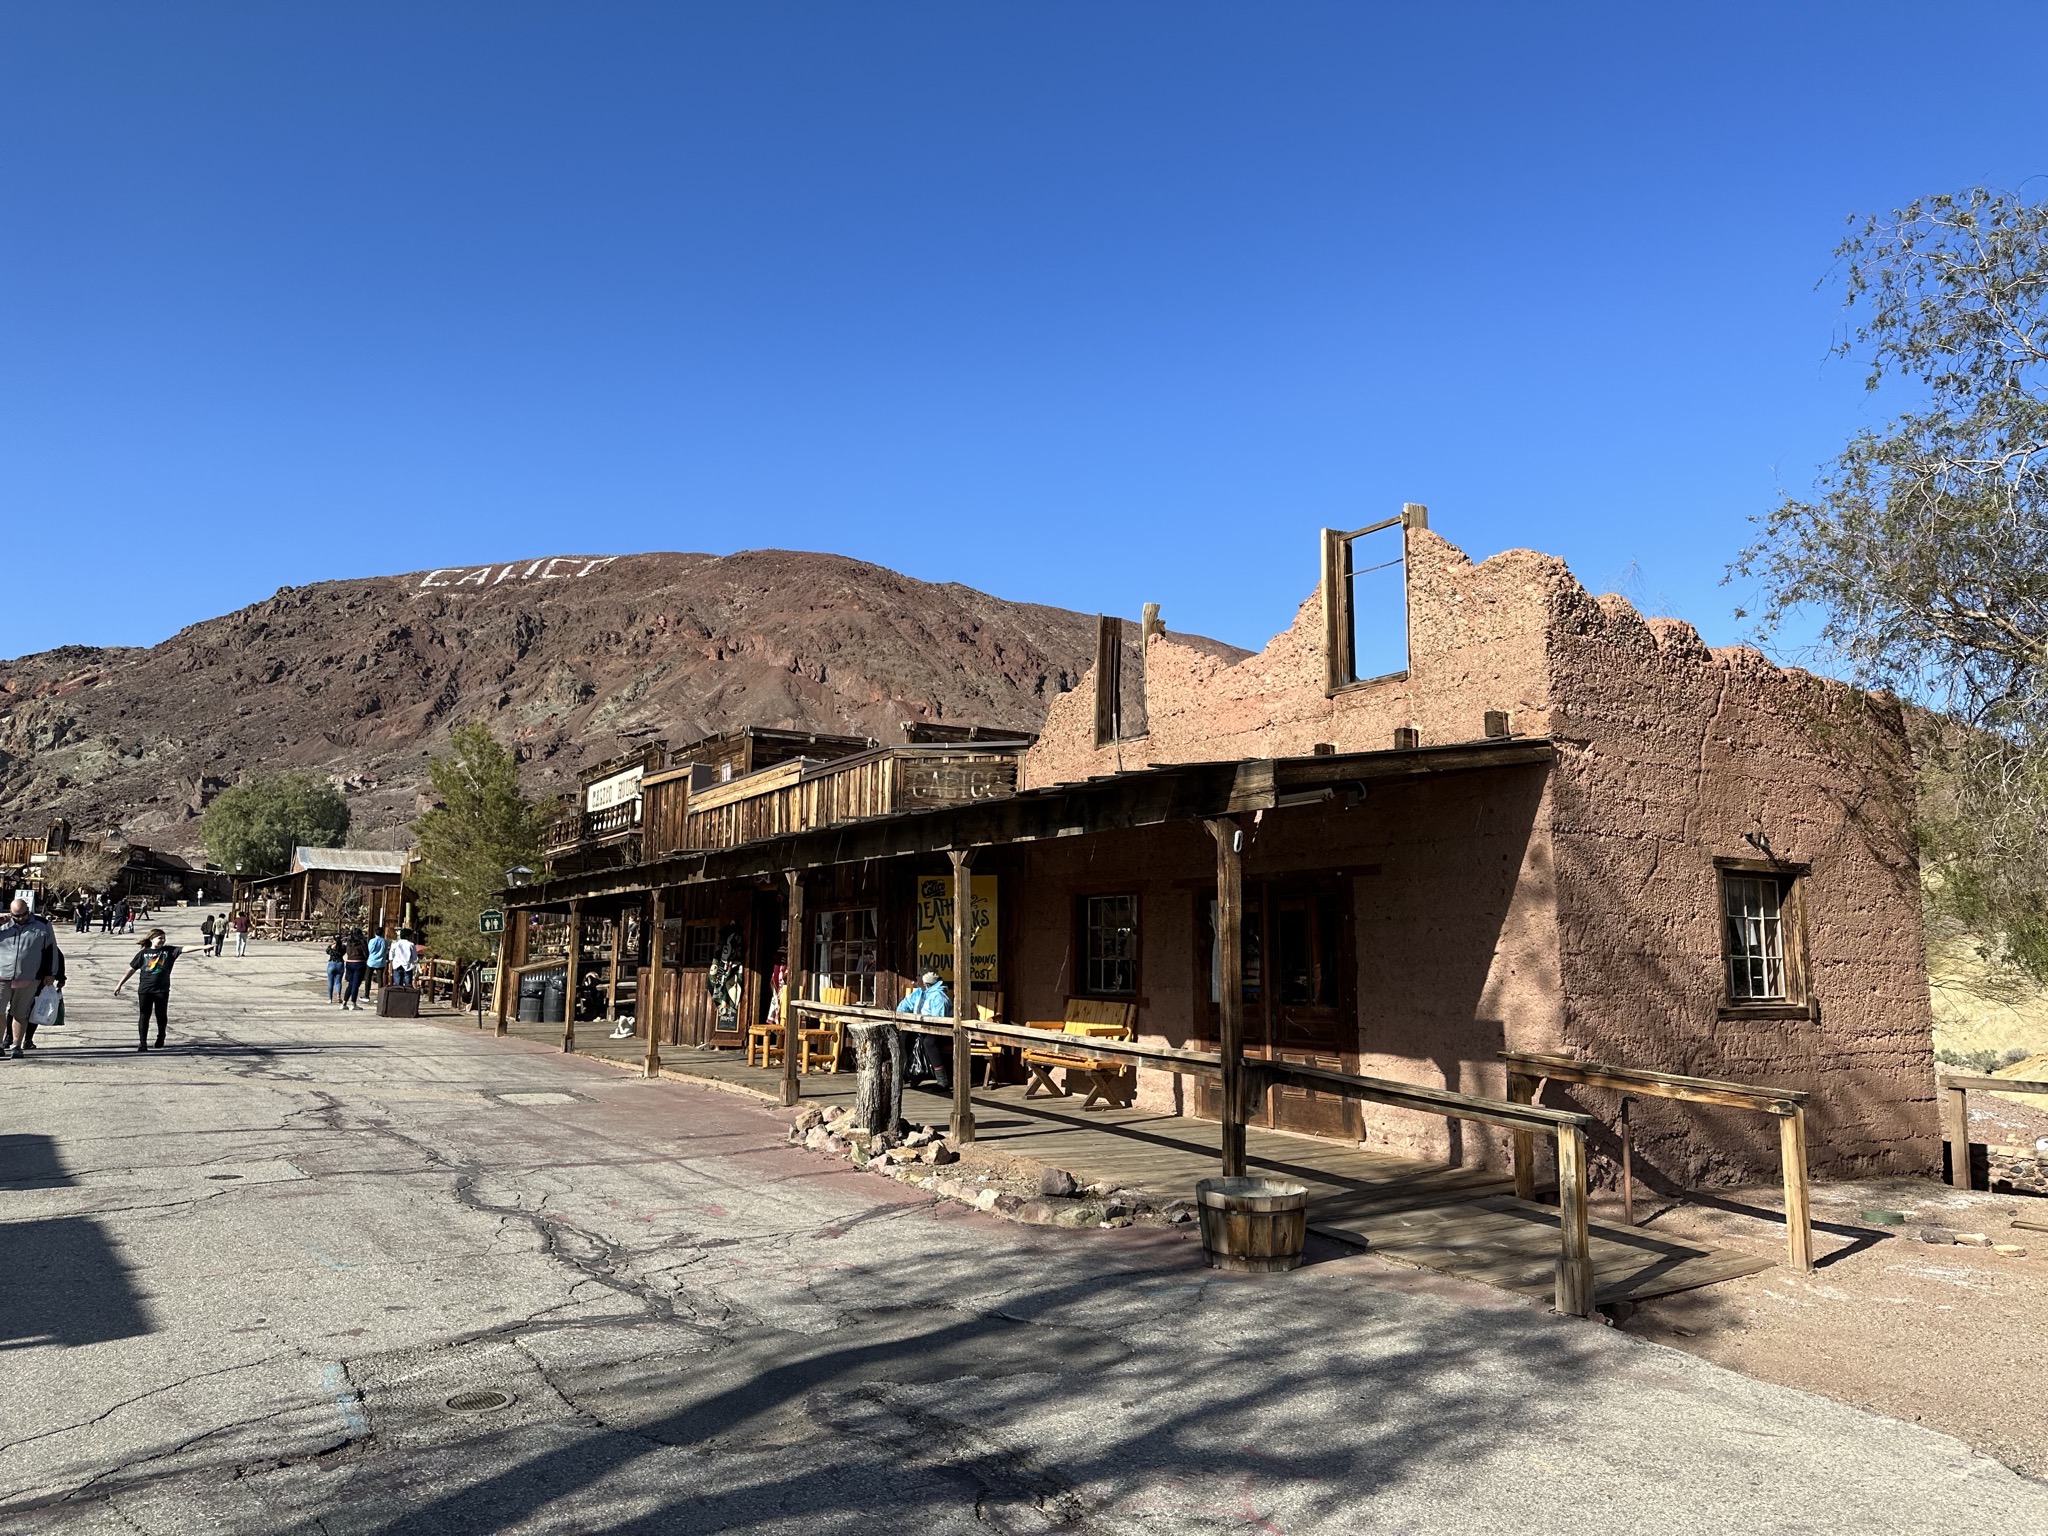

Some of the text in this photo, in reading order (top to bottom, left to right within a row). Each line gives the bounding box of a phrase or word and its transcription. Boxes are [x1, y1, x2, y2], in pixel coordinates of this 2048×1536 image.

[917, 898, 955, 932] LEATH
[938, 909, 990, 944] WKS
[919, 952, 955, 971] INDIA
[970, 953, 997, 967] RADING
